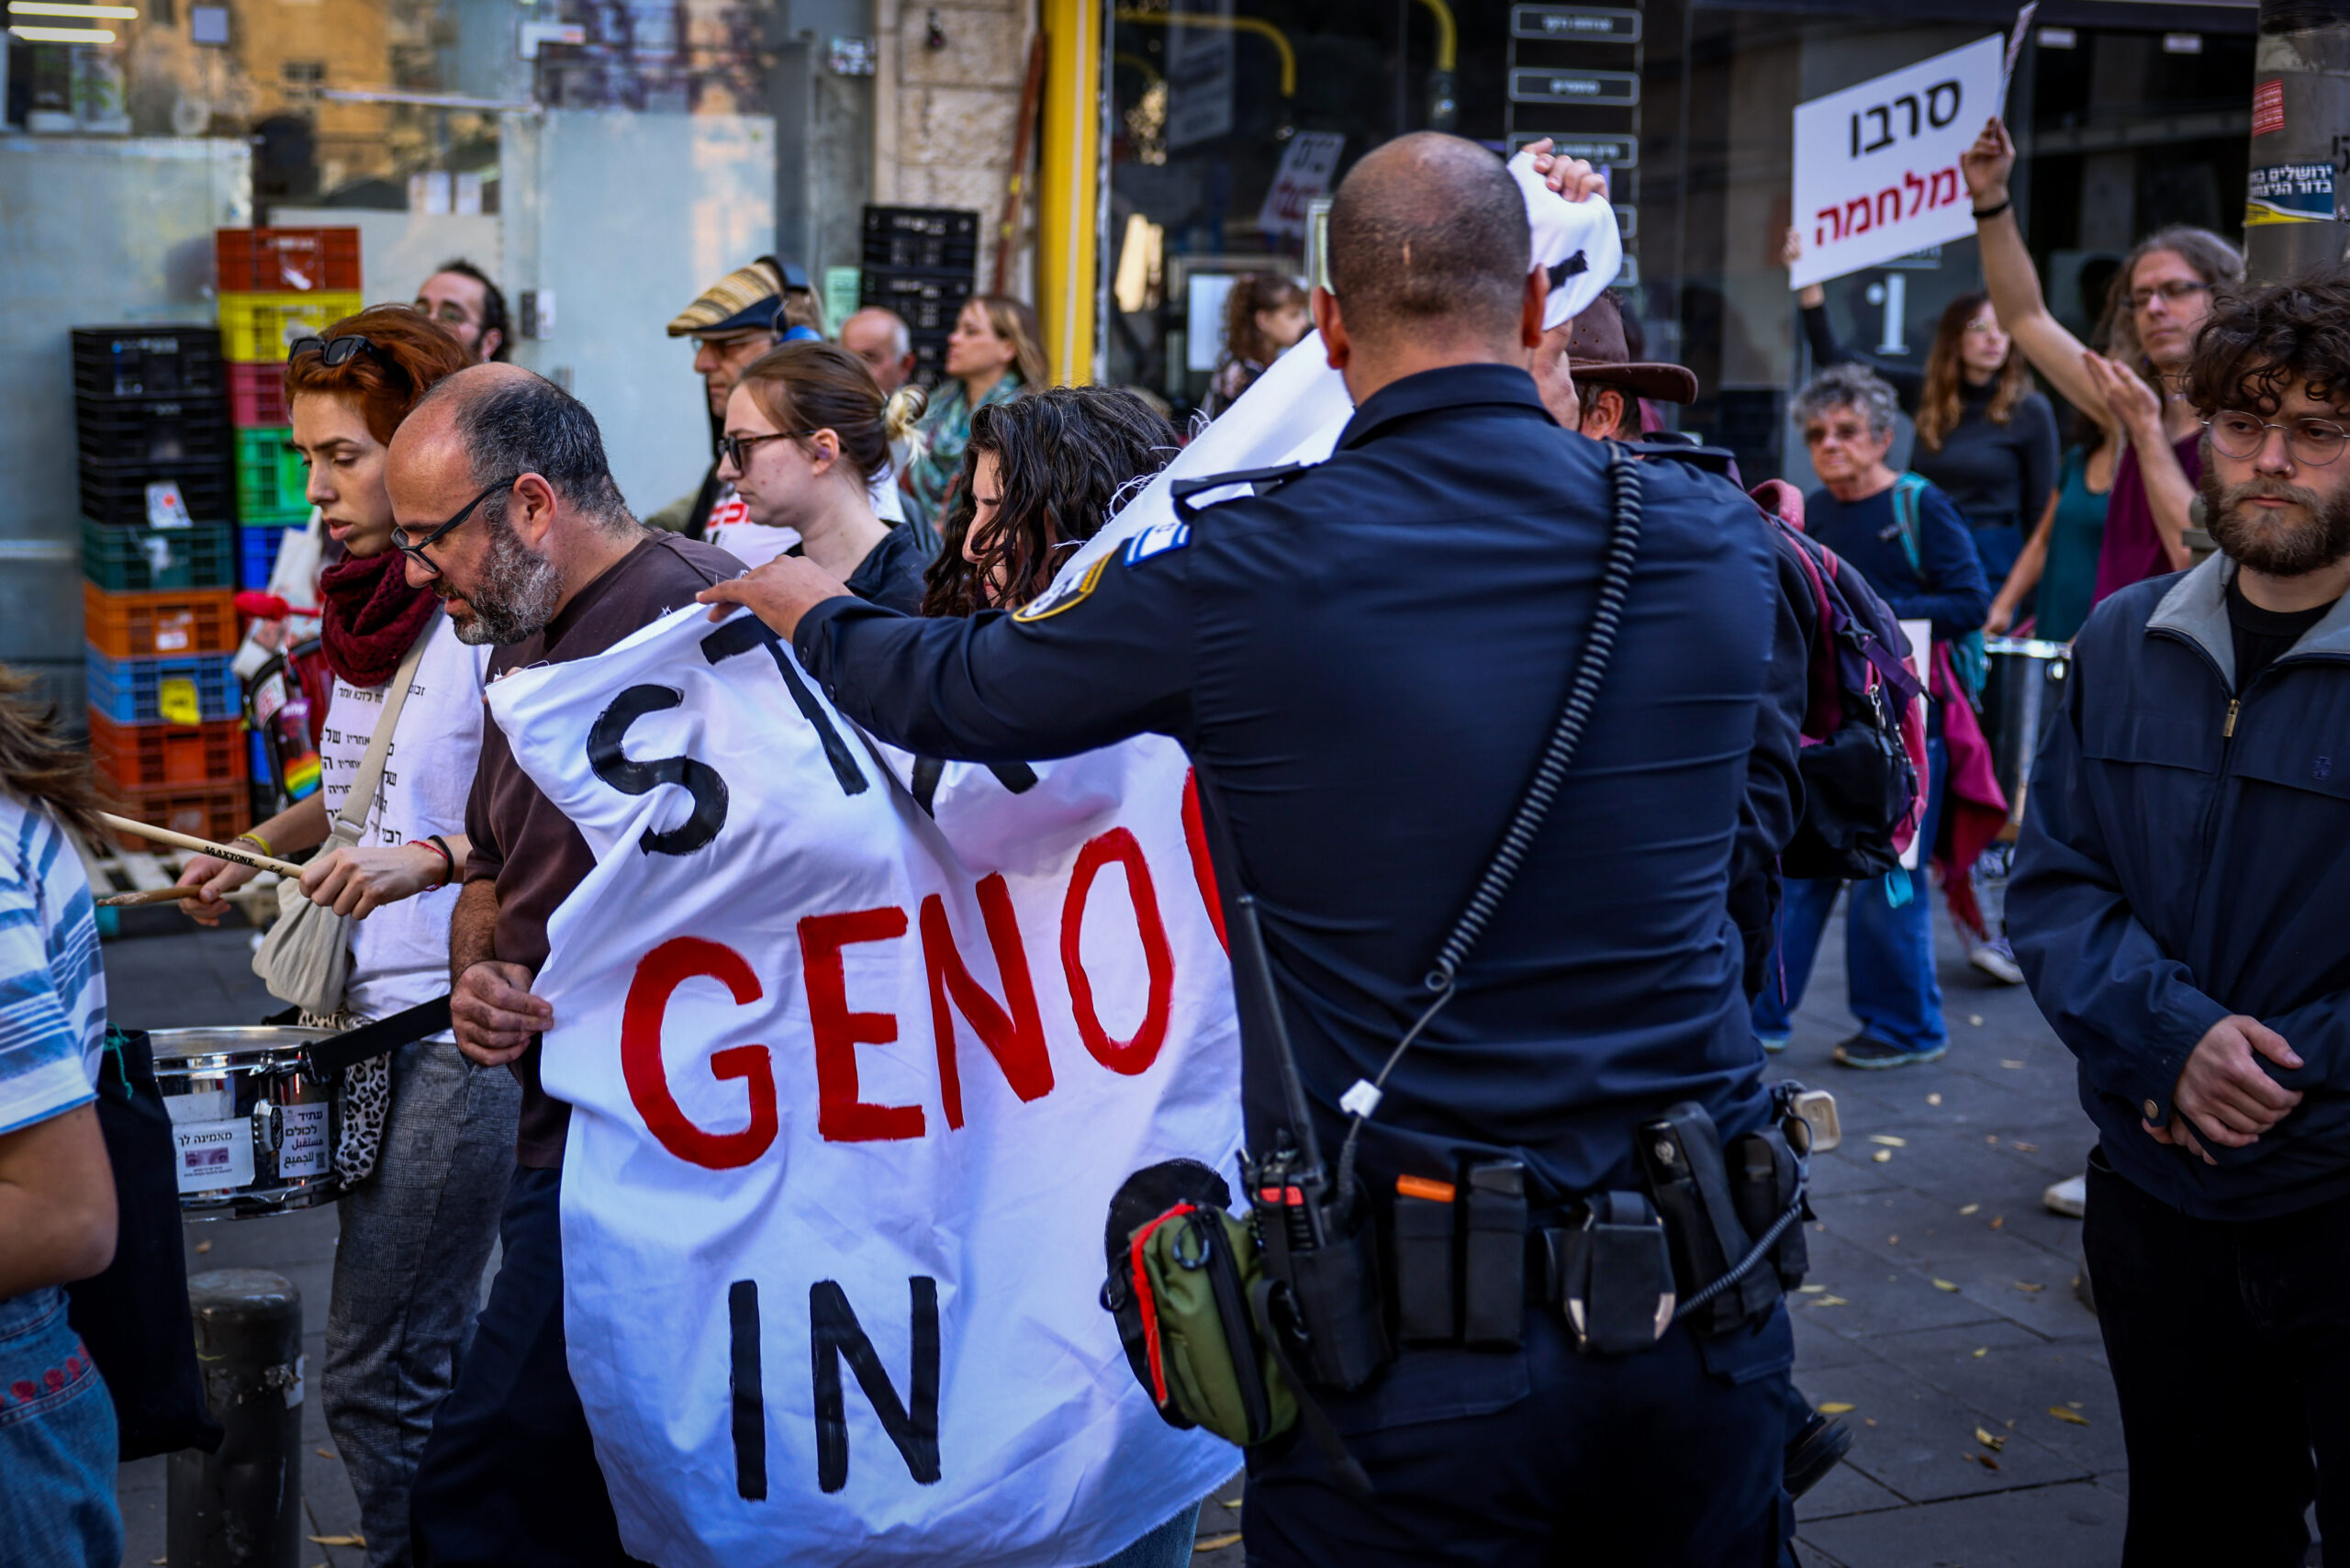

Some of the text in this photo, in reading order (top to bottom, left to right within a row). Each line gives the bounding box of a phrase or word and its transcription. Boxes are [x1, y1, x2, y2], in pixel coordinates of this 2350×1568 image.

[1850, 80, 1963, 158] סרבו
[2268, 164, 2333, 183] ירושלים
[2297, 179, 2333, 195] בדור
[1816, 159, 1974, 247] מלחמה
[587, 614, 1039, 857] ST
[338, 759, 362, 769] חריו
[328, 785, 352, 794] חריה
[621, 766, 1232, 1170] GENO
[297, 1111, 323, 1122] עתיד
[285, 1124, 318, 1137] לכולם
[178, 1131, 233, 1148] מאמינה לך
[292, 1137, 323, 1150] مستقبل
[284, 1151, 315, 1169] للجميع
[729, 1275, 942, 1503] IN
